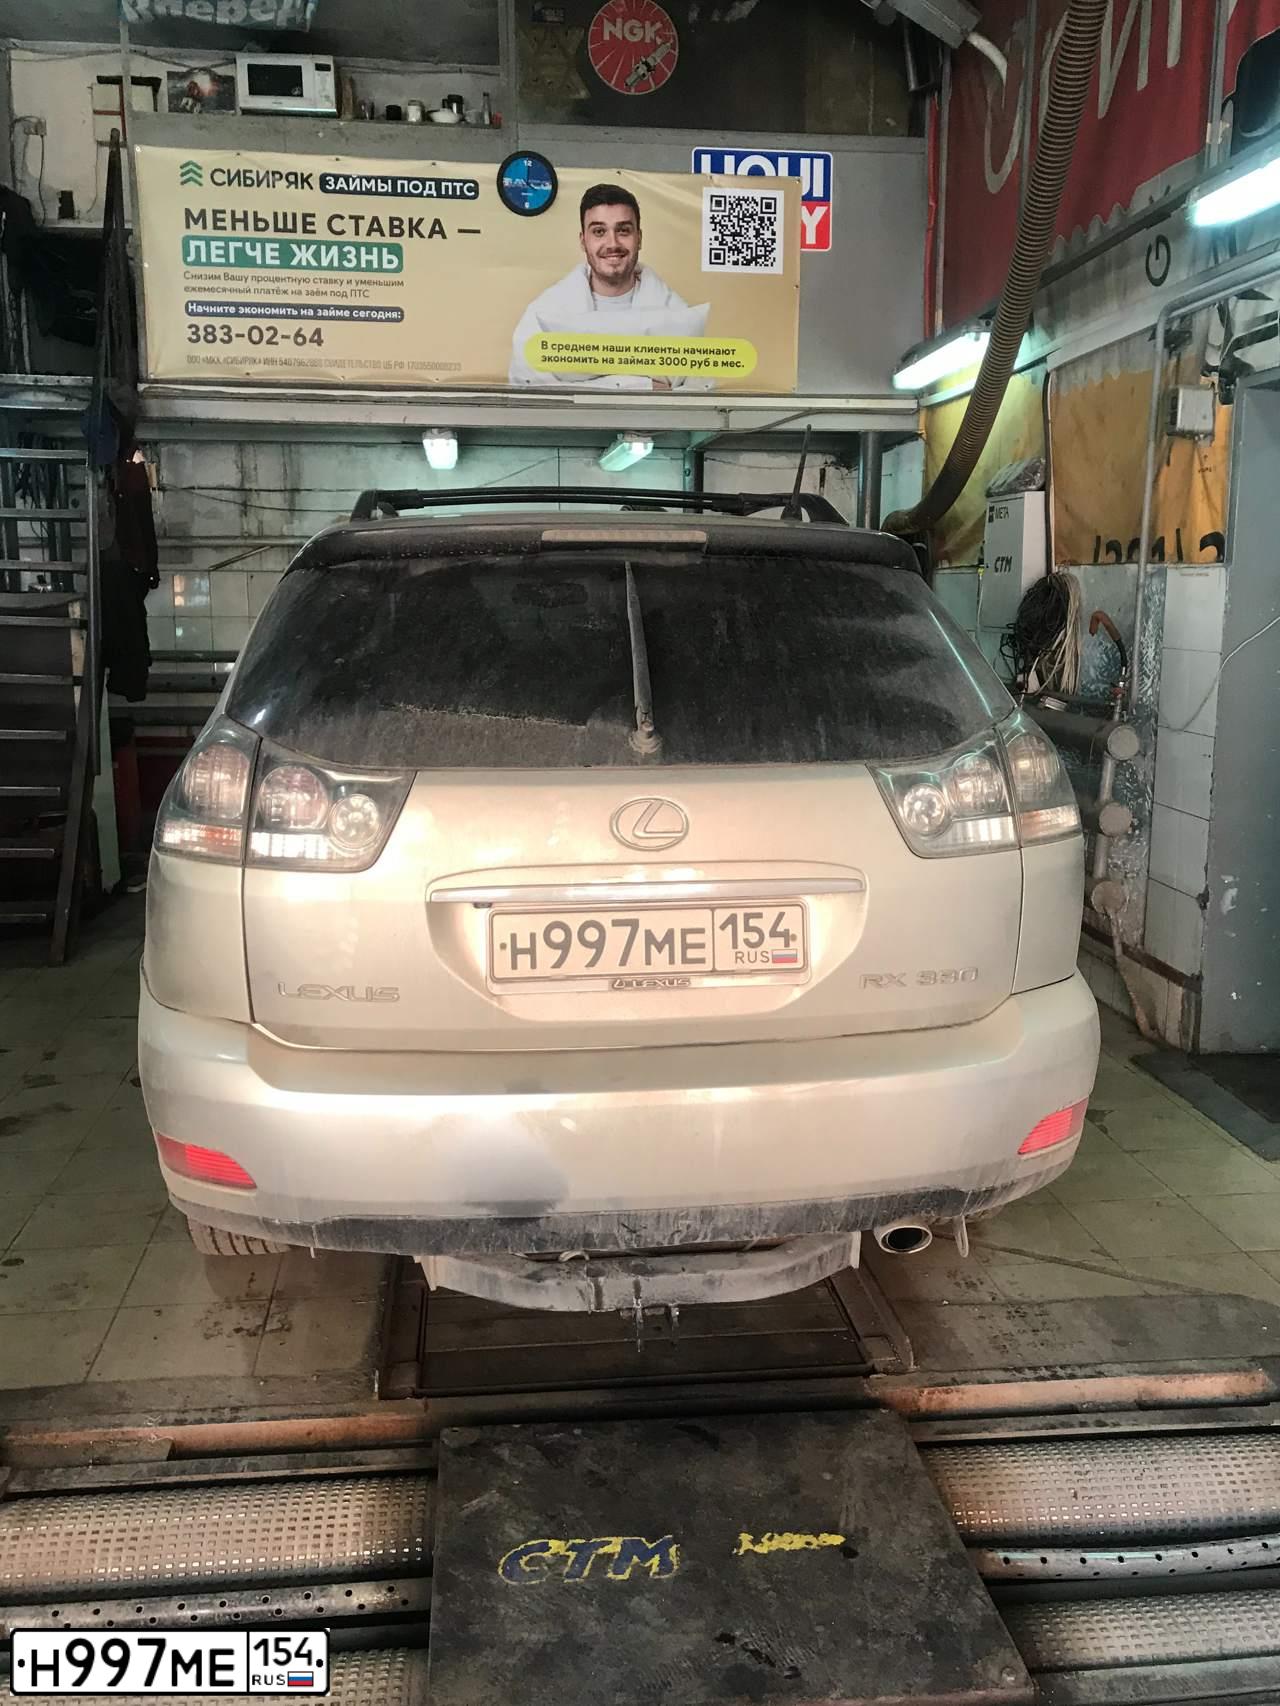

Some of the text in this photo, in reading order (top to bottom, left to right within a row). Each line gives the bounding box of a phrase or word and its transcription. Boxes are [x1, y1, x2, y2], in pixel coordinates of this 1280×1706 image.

[603, 18, 663, 43] NGK
[209, 168, 475, 197] СИБИРЯК ЗАЙМЫ ПОД ПТС
[184, 208, 317, 234] МЕНЬШЕ
[327, 213, 447, 239] СТАВКА
[186, 239, 399, 269] ЛЕГЧЕ ЖИЗНЬ
[184, 271, 221, 282] Снизим
[224, 273, 248, 284] Вашу
[251, 275, 310, 286] процентную
[313, 277, 345, 287] ставку
[355, 279, 404, 288] уменьшим
[184, 285, 251, 295] ежемесячный
[254, 286, 289, 296] платёж
[305, 287, 328, 297] заём
[330, 290, 348, 299] под
[350, 289, 369, 298] ПТС
[188, 302, 402, 320] Начните экономить на займе сегодня:
[187, 323, 324, 347] 383-02-64
[541, 341, 736, 356] В среднем наши клиенты начинают
[541, 354, 599, 364] экономить
[602, 356, 614, 365] на
[618, 355, 656, 366] займах
[659, 357, 687, 367] 3000
[690, 357, 710, 369] руб
[721, 360, 744, 368] мес.
[510, 911, 792, 971] Н997МЕ 154
[735, 950, 770, 965] RUS
[632, 978, 689, 988] LEXUS
[859, 972, 908, 989] RX
[277, 983, 400, 1002] LEXUS
